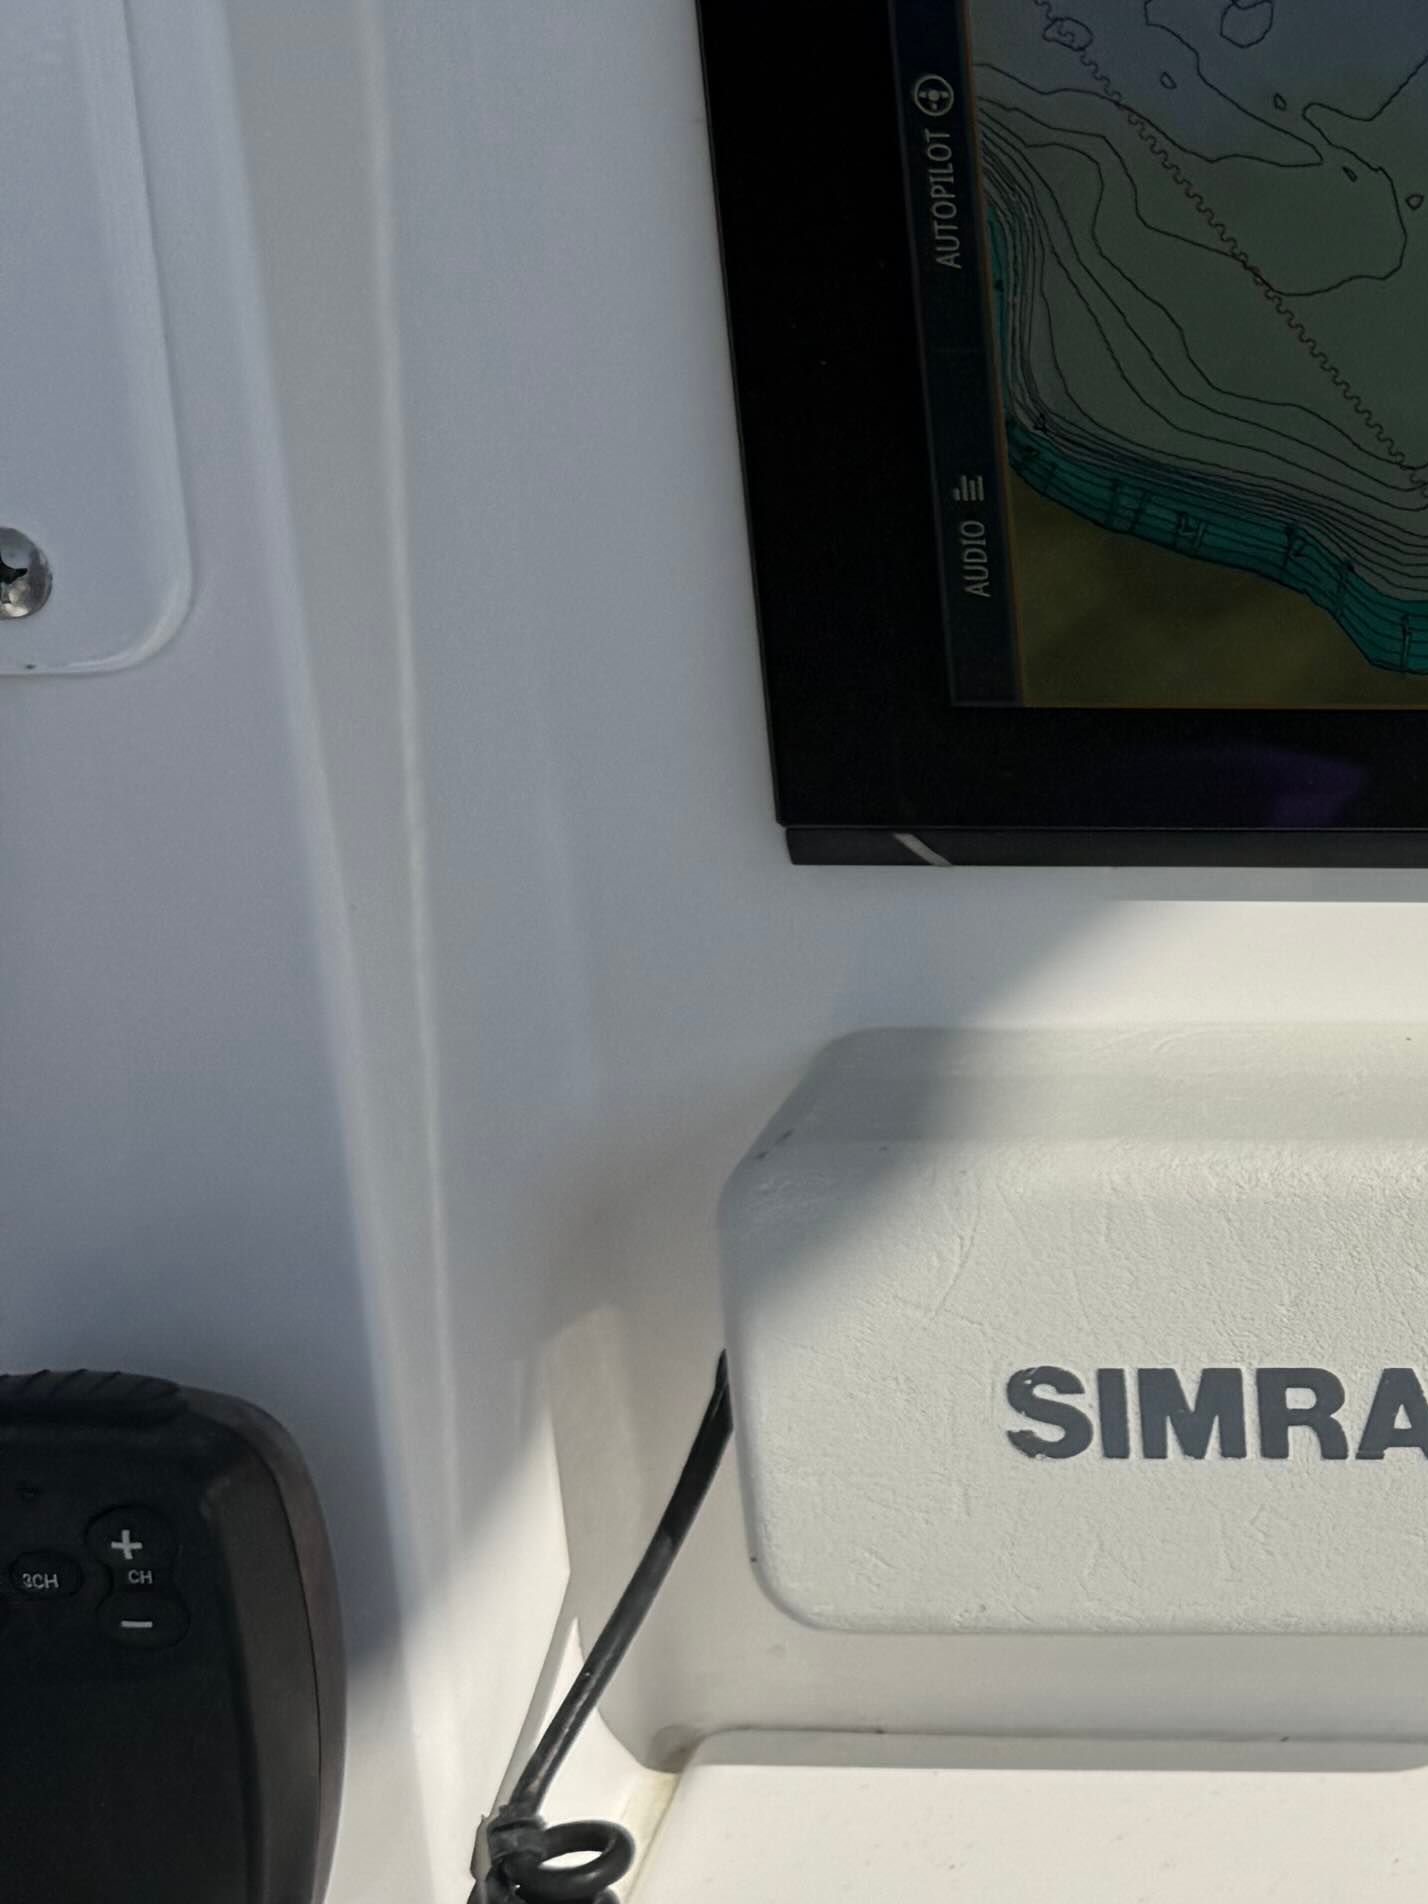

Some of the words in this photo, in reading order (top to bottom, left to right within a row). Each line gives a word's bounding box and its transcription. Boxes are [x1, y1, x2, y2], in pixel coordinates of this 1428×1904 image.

[934, 127, 962, 270] AUTOPILOT
[961, 518, 992, 599] AUDIO
[127, 1568, 154, 1585] CH
